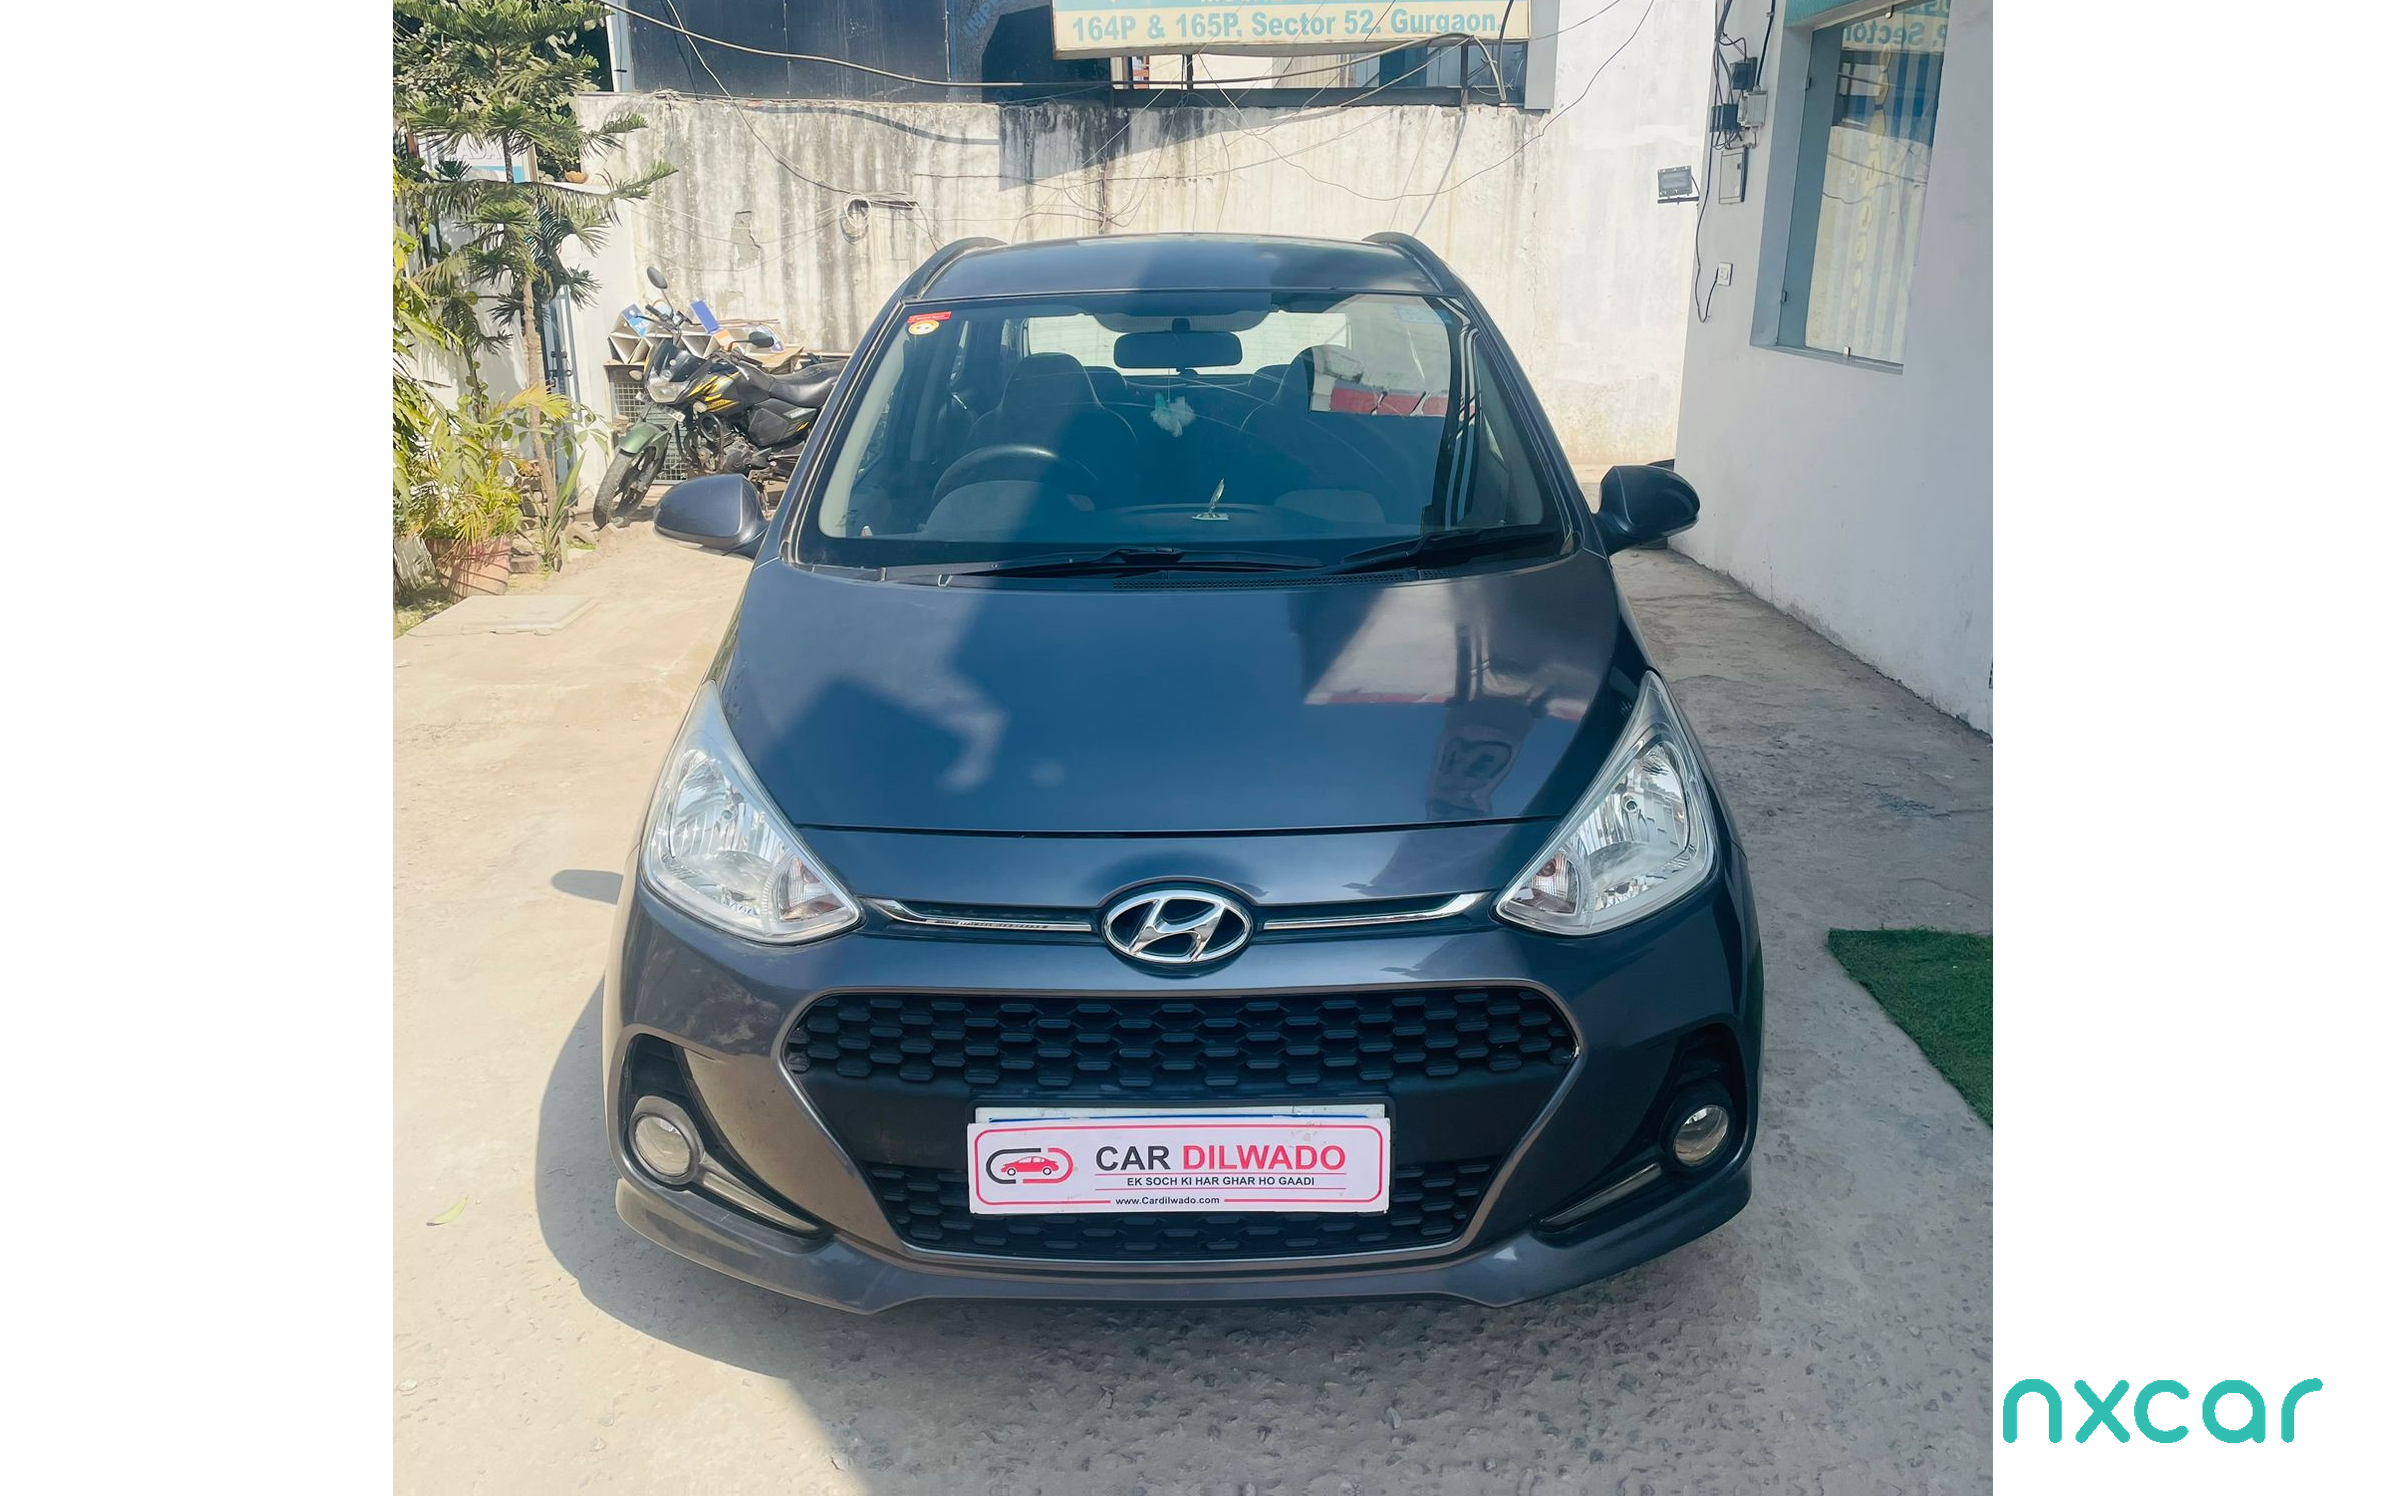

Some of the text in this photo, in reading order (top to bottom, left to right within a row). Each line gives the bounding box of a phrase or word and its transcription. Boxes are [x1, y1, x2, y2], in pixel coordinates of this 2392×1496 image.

[1073, 15, 1137, 42] 164P
[1147, 14, 1166, 40] &
[1175, 12, 1243, 38] 165P,
[1251, 11, 1336, 37] Sector
[1095, 1143, 1346, 1172] CAR DILWADO
[1127, 1176, 1315, 1187] EK SOCH KI HAR GHAR HO GAADI
[1115, 1195, 1220, 1206] www.Cardilwado.com
